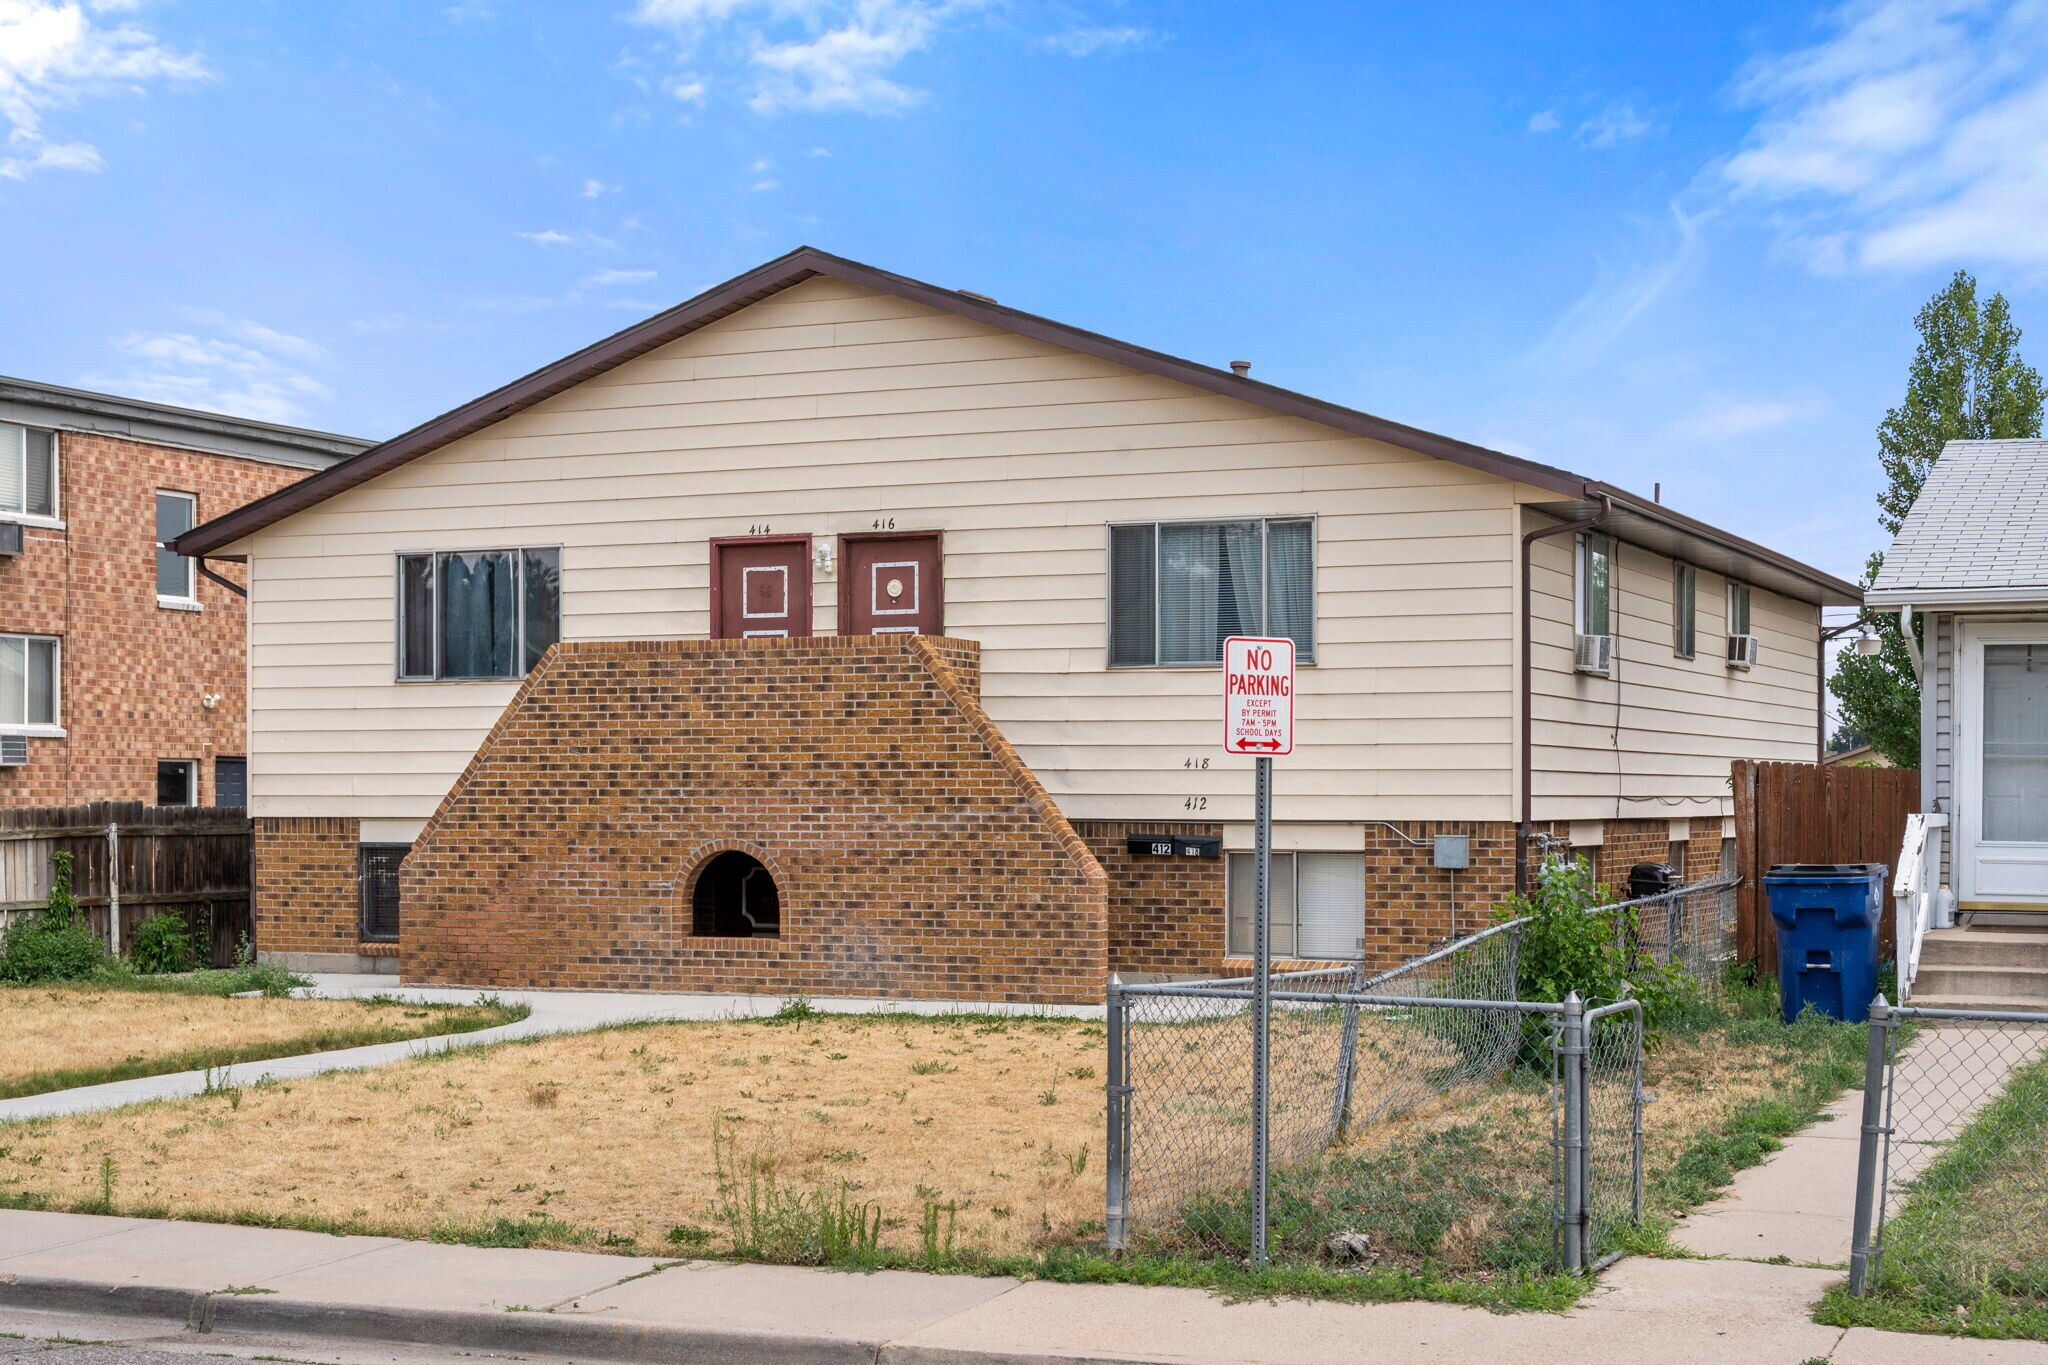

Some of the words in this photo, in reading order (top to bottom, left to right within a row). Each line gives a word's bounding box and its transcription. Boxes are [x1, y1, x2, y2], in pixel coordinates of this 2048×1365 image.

[749, 524, 771, 536] 414
[872, 517, 895, 531] 416
[1247, 649, 1272, 671] NO
[1230, 674, 1289, 697] PARKING
[1247, 699, 1272, 708] EXCEPT
[1241, 709, 1250, 717] BY
[1253, 709, 1277, 718] PERMIT
[1242, 719, 1256, 727] 7AM
[1262, 719, 1277, 728] 5PM
[1236, 728, 1263, 737] SCHOOL
[1264, 729, 1282, 738] DAYS
[1184, 757, 1210, 769] 418
[1184, 796, 1207, 811] 412
[1152, 844, 1171, 854] 412
